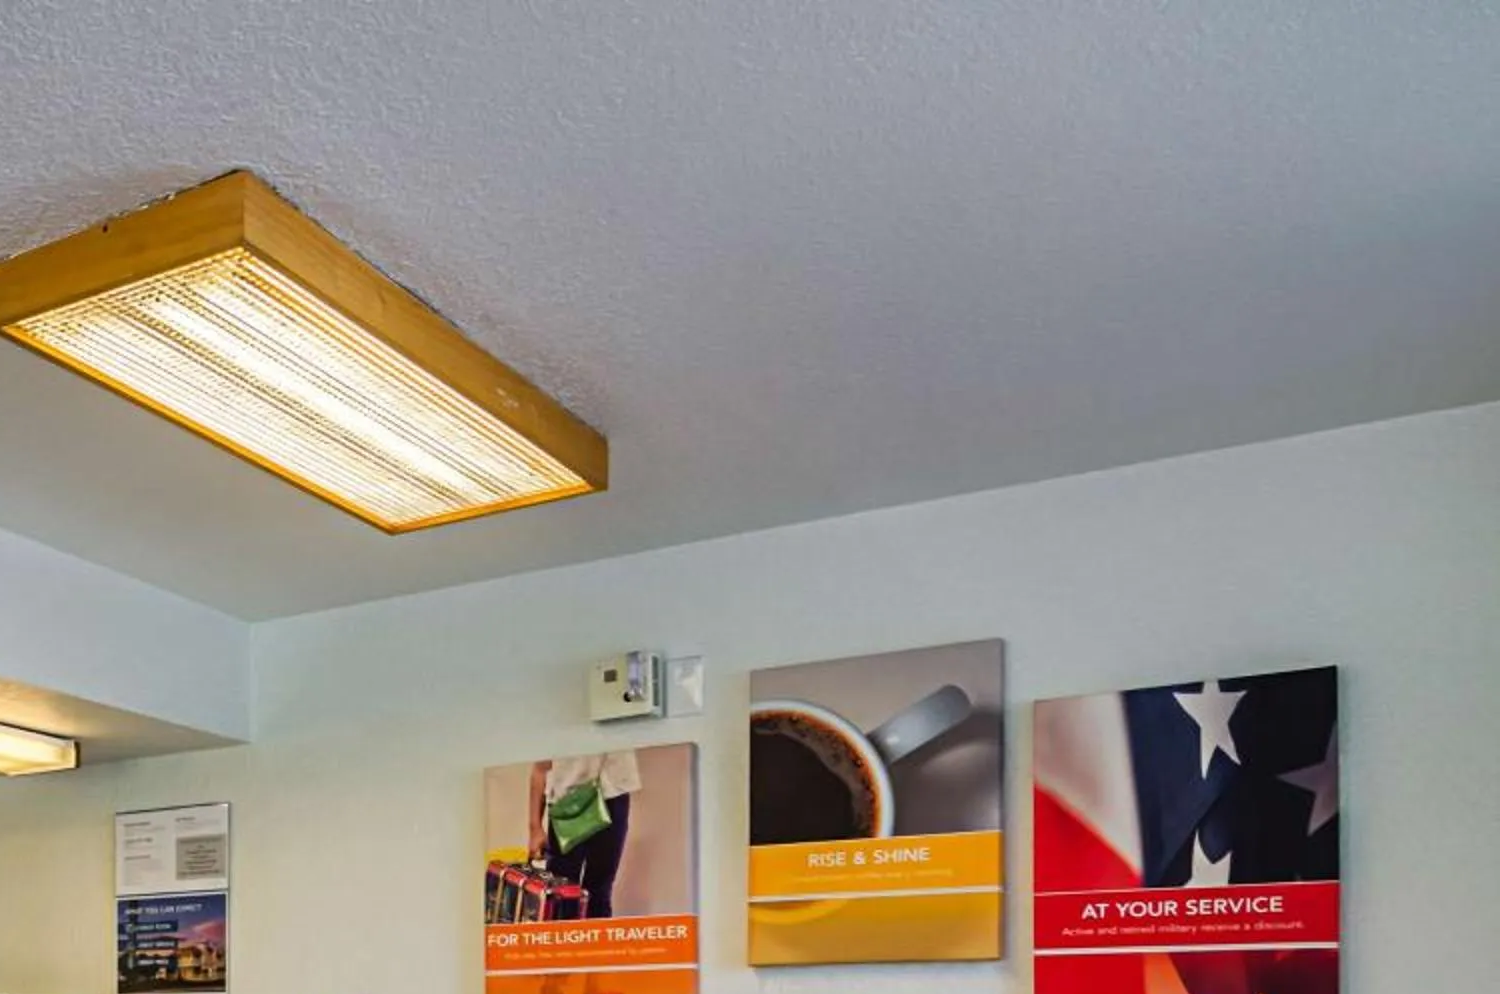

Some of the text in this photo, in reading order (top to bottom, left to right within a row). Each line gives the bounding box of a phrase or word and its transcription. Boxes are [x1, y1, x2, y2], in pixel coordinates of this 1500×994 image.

[807, 847, 931, 868] RISE & SHINE
[1081, 896, 1284, 919] AT YOUR SERVICE
[488, 924, 687, 947] FOR THE LIGHT TRAVELER
[1097, 926, 1117, 935] and
